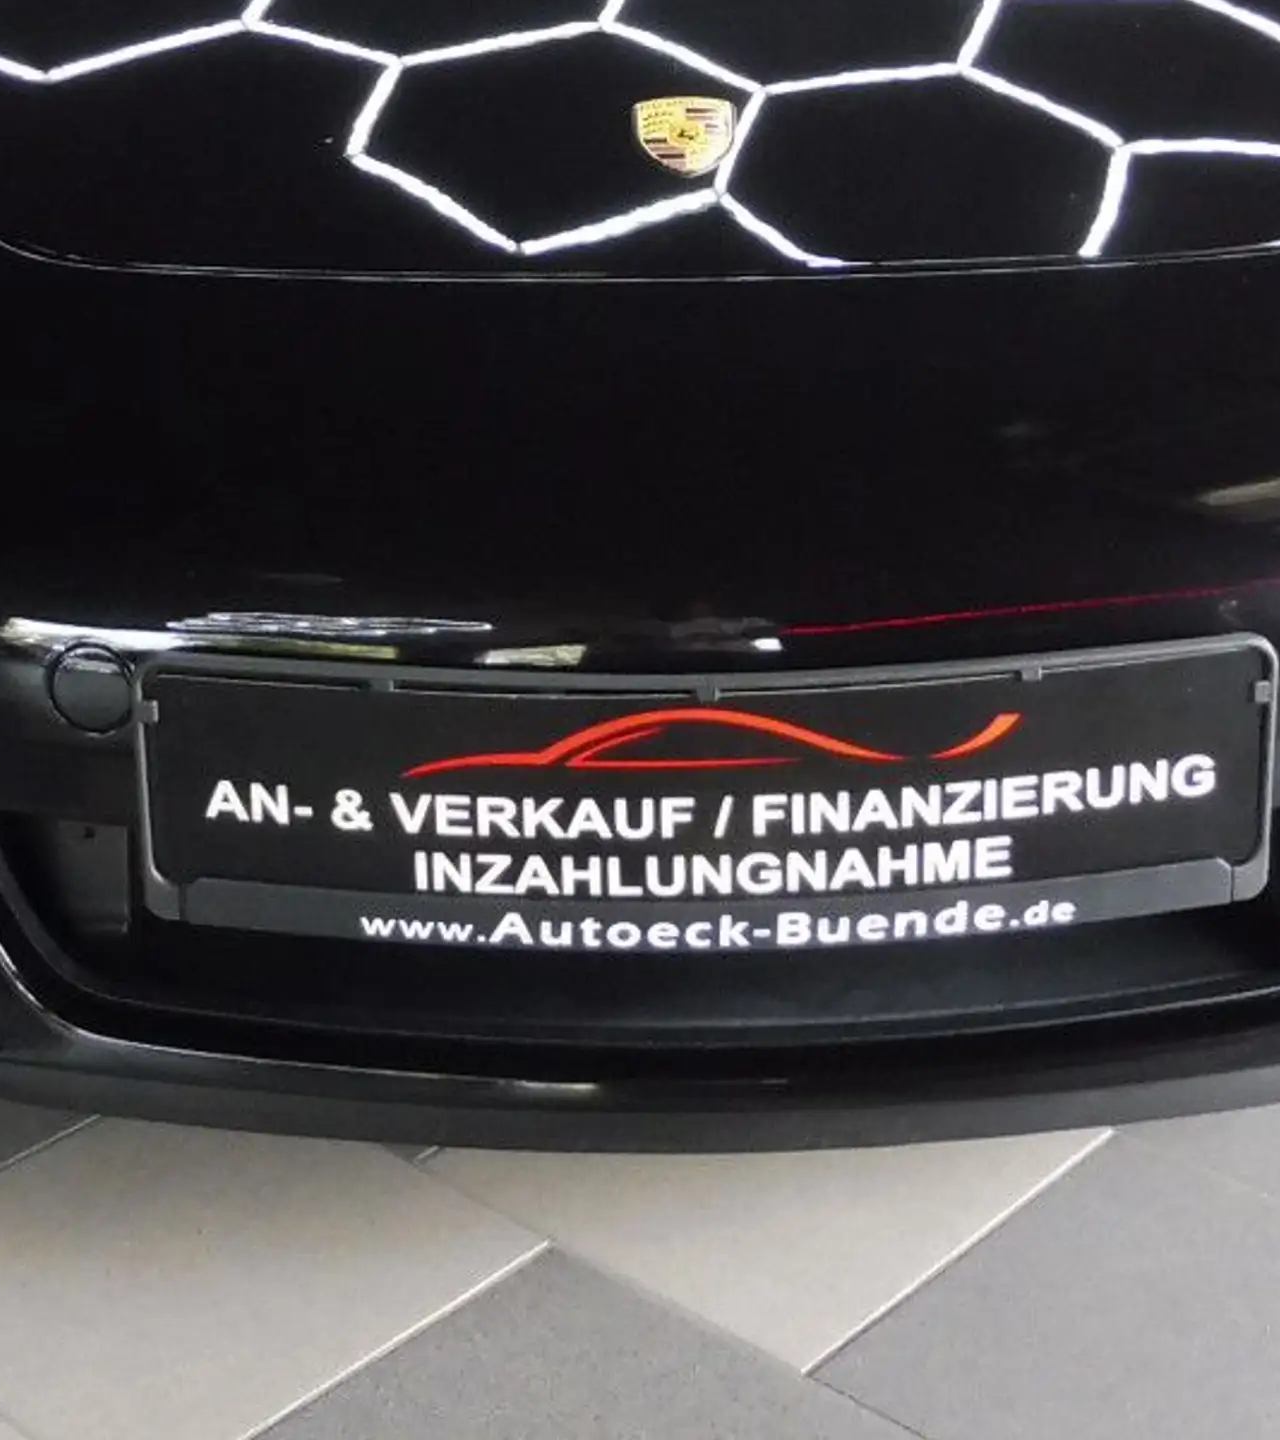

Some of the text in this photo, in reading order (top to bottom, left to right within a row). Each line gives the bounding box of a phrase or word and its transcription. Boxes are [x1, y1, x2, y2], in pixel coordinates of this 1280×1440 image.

[204, 753, 1217, 841] AN- & VERKAUF / FINANZIERUNG
[413, 835, 1014, 897] INZAHLUNGNAHME
[359, 898, 1078, 950] www.Autoeck-Buende.de
